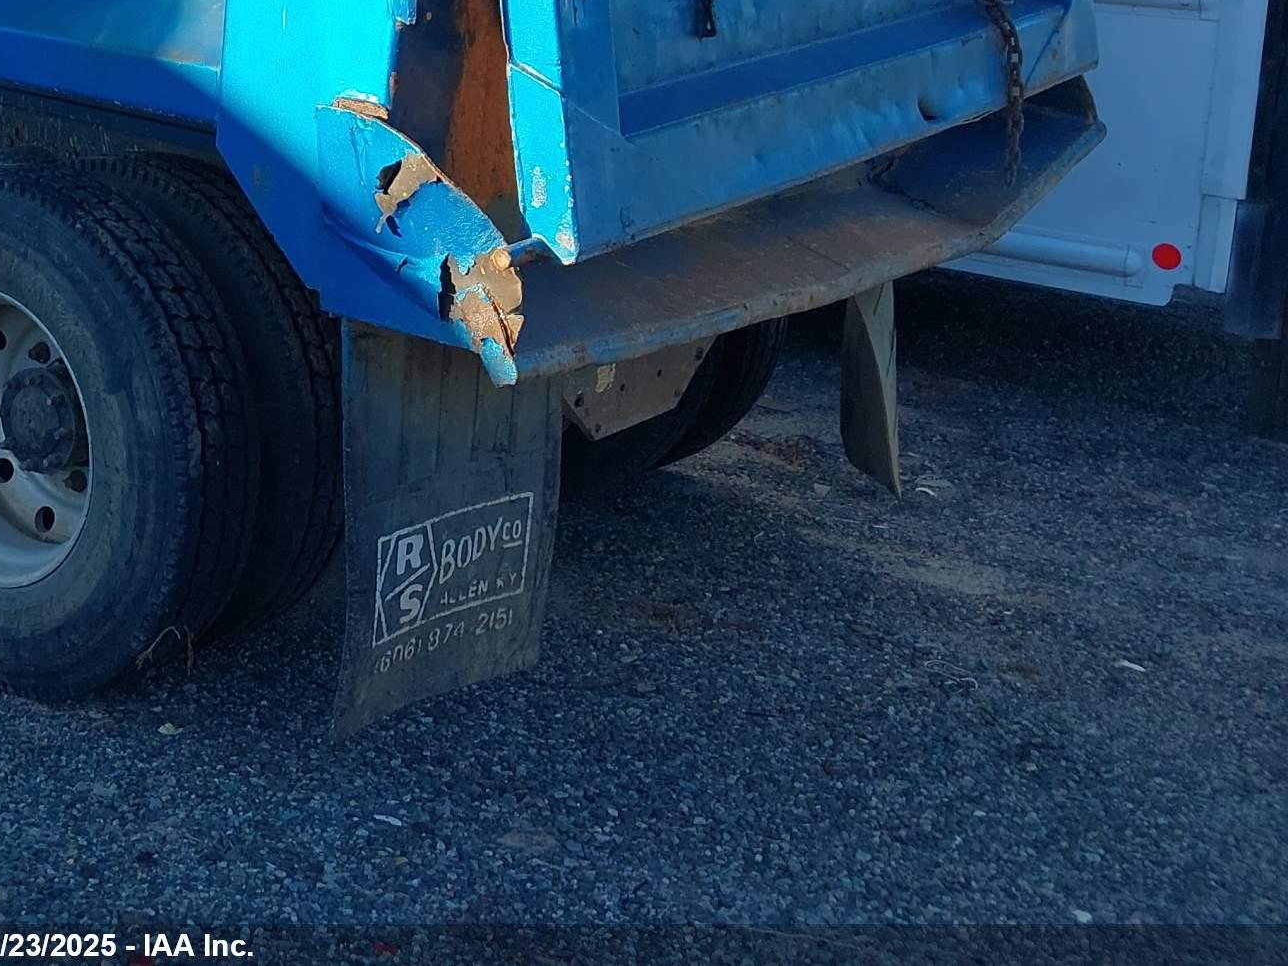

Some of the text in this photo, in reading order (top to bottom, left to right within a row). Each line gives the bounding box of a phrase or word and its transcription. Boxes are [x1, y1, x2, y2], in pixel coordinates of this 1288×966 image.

[396, 534, 424, 576] R
[439, 516, 503, 584] BODY
[399, 584, 423, 624] S
